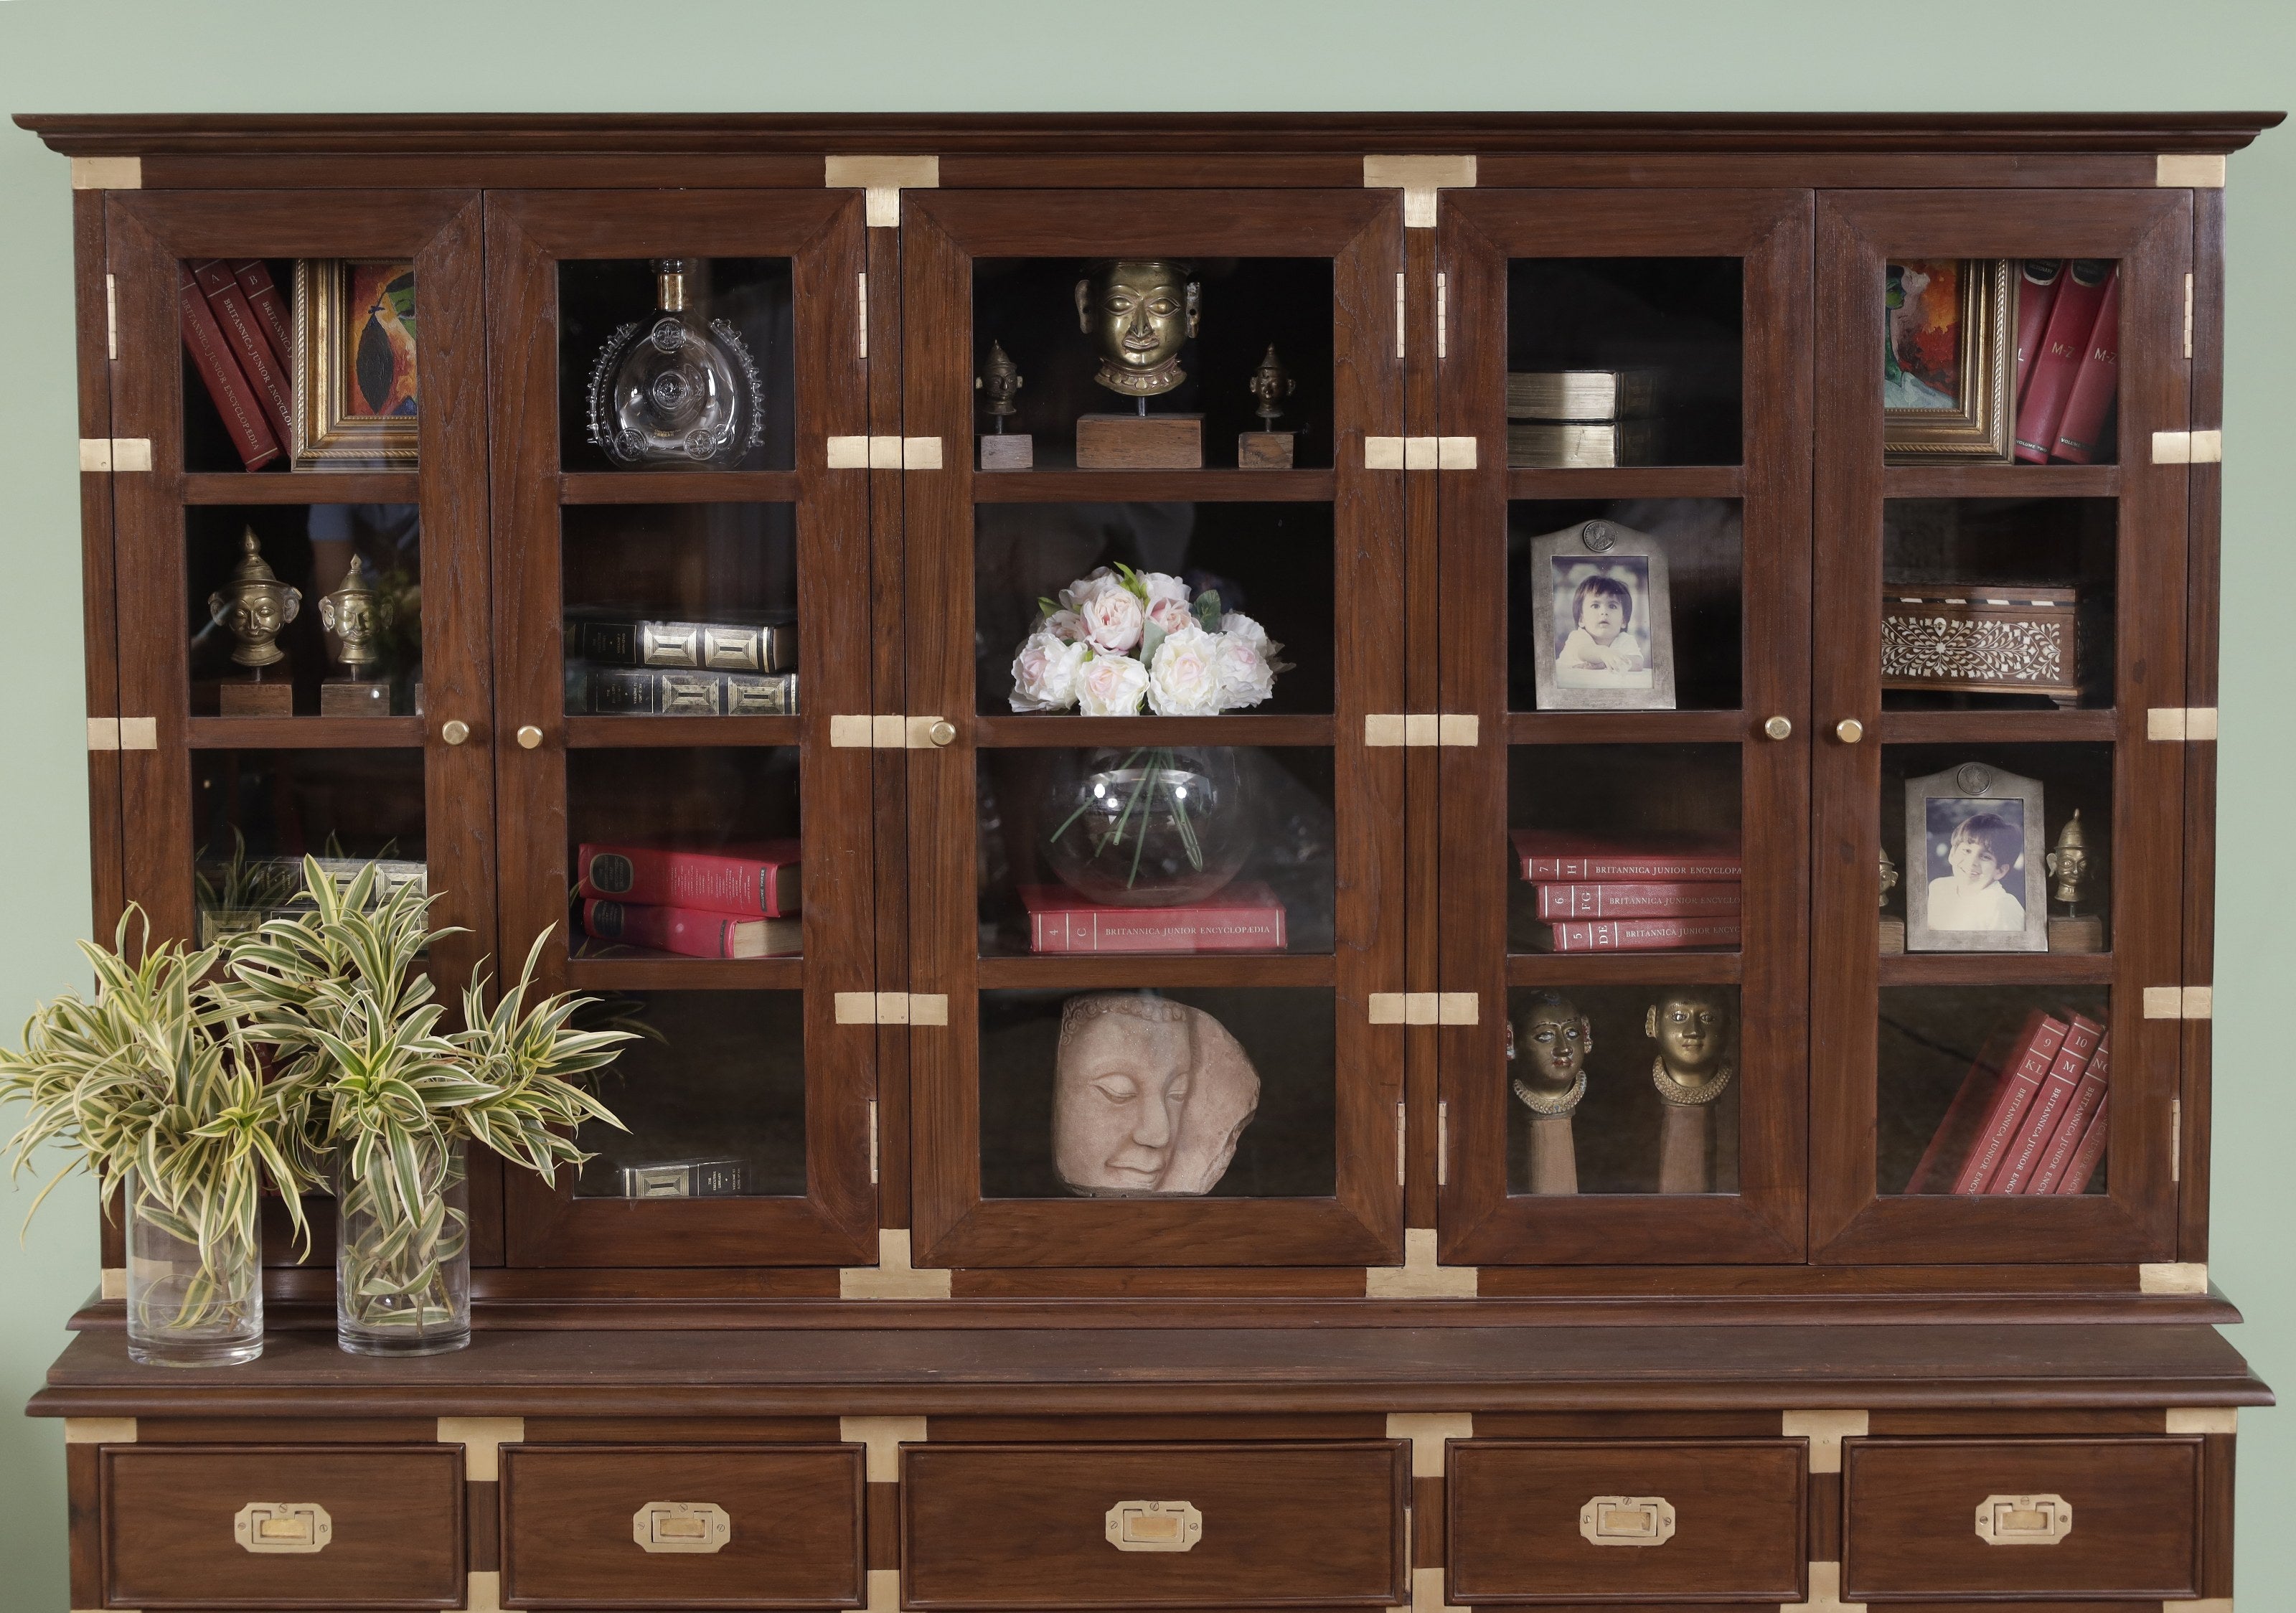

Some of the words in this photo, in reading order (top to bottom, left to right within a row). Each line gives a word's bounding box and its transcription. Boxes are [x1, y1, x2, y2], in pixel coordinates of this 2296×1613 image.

[212, 274, 220, 283] A
[248, 275, 258, 286] B
[223, 298, 253, 350] BRITANNICA
[248, 350, 271, 383] JUNIOR
[2051, 342, 2075, 359] M-Z
[2094, 348, 2117, 365] M-Z
[181, 298, 210, 351] BRITANNICA
[205, 352, 227, 384] JUNIOR
[224, 385, 260, 450] ENCYCLOPÆDIA
[2015, 439, 2035, 449] VOLUME
[1567, 865, 1577, 875] H
[1595, 866, 1650, 875] BRITANNICA
[1652, 866, 1686, 875] JUNIOR
[1609, 897, 1662, 906] BRITANNICA
[1664, 898, 1698, 906] JUNIOR
[1076, 927, 1087, 937] C
[1105, 928, 1160, 936] BRITANNICA
[1162, 926, 1197, 937] JUNIOR
[1200, 925, 1271, 935] ENCYCLOPÆDIA
[1626, 928, 1677, 938] BRITANNICA
[1678, 928, 1711, 938] JUNIOR
[2043, 1038, 2052, 1048] 9
[2075, 1035, 2088, 1048] 10
[2063, 1060, 2076, 1073] M
[1996, 1087, 2027, 1137] BRITANNICA
[2033, 1087, 2061, 1138] BRITANNICA
[2064, 1086, 2095, 1137] BRITANNICA
[1980, 1136, 2000, 1170] JUNIOR
[2015, 1138, 2037, 1171] JUNIOR
[2048, 1136, 2069, 1170] JUNIOR
[2079, 1136, 2099, 1169] JUNIOR
